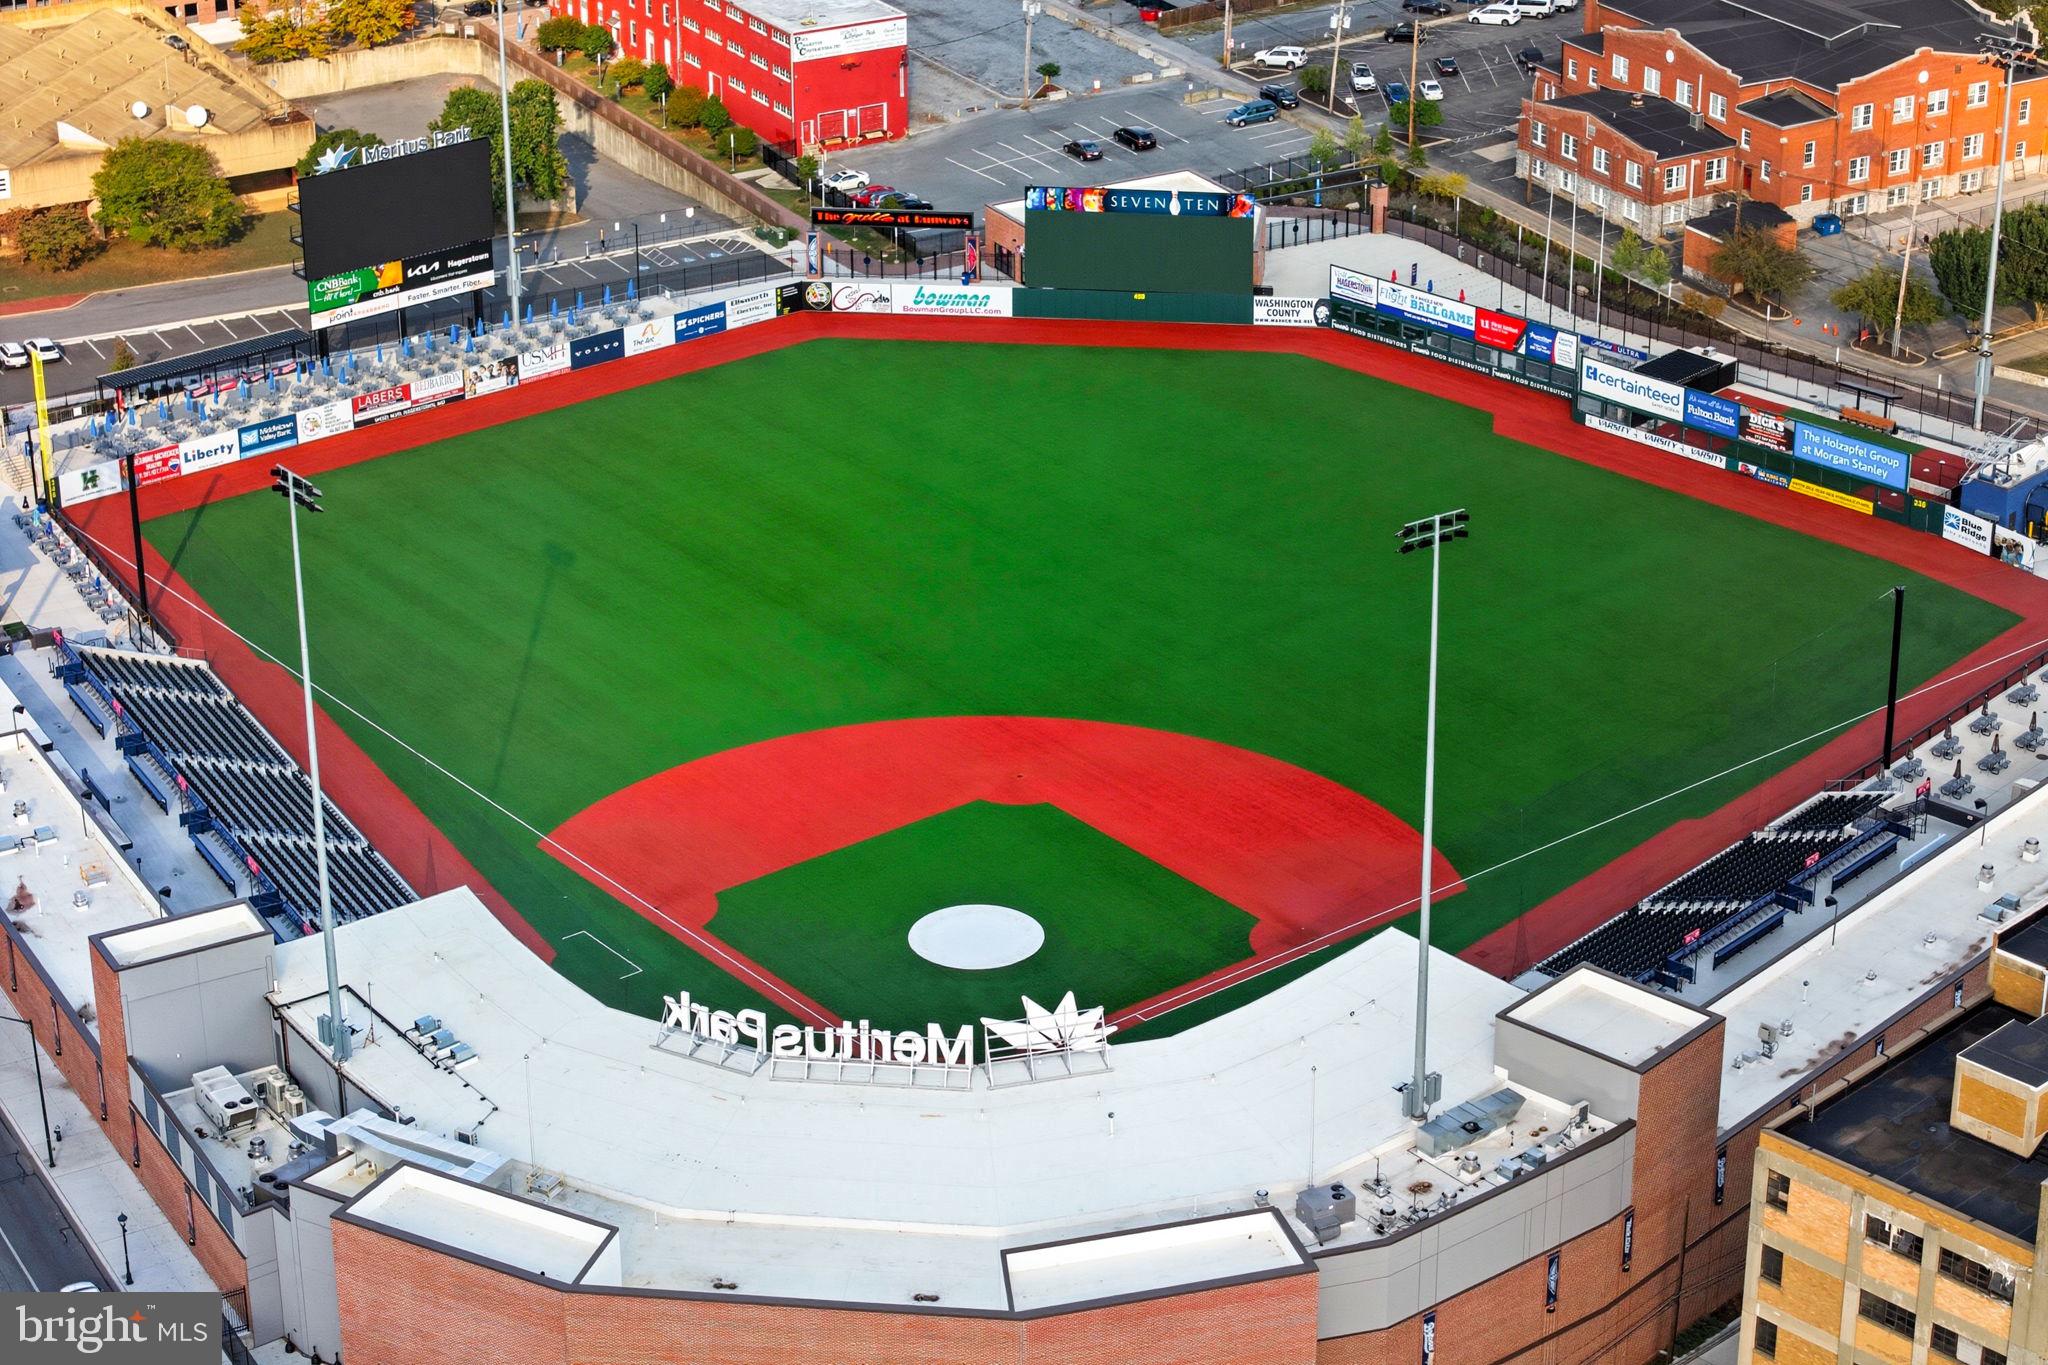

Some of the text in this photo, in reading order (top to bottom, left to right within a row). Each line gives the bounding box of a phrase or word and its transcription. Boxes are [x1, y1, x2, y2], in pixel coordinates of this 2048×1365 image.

[362, 125, 472, 165] Meritus Park
[1110, 195, 1219, 211] SEVEN TEN
[816, 211, 840, 221] The
[897, 215, 910, 223] at
[447, 252, 490, 269] Hagerstown
[432, 285, 461, 297] Smarter.
[913, 285, 991, 308] bowman
[902, 305, 1002, 315] BowmanGroupLLC.com
[1254, 299, 1314, 309] WASHINGTON
[1411, 299, 1440, 316] BALL
[1441, 308, 1474, 326] GAME
[687, 310, 725, 327] SPICHERS
[1266, 308, 1301, 318] COUNTY
[574, 340, 620, 357] VOLVO
[633, 338, 645, 347] The
[1366, 333, 1408, 349] DISTRIBUTORS
[1617, 346, 1640, 359] ULTRA
[1448, 356, 1489, 374] DISTRIBUTORS
[1530, 380, 1573, 399] DISTRIBUTORS
[1598, 372, 1681, 407] certainteed
[358, 388, 403, 409] LABERS
[1687, 403, 1713, 421] Fulton
[1713, 411, 1736, 427] Bank
[1749, 413, 1785, 432] DICK'S
[259, 421, 294, 436] Middletown
[259, 428, 292, 442] Valley Bank
[1598, 418, 1630, 435] VARSITY
[1644, 433, 1678, 450] VARSITY
[1803, 429, 1820, 443] The
[1822, 436, 1868, 459] Holzapfel
[1869, 450, 1900, 469] Group
[183, 443, 235, 464] Liberty
[1690, 447, 1724, 464] VARSITY
[1801, 444, 1889, 480] at Morgan Stanley
[1961, 517, 1983, 532] Blue
[1960, 525, 1987, 542] Ridge
